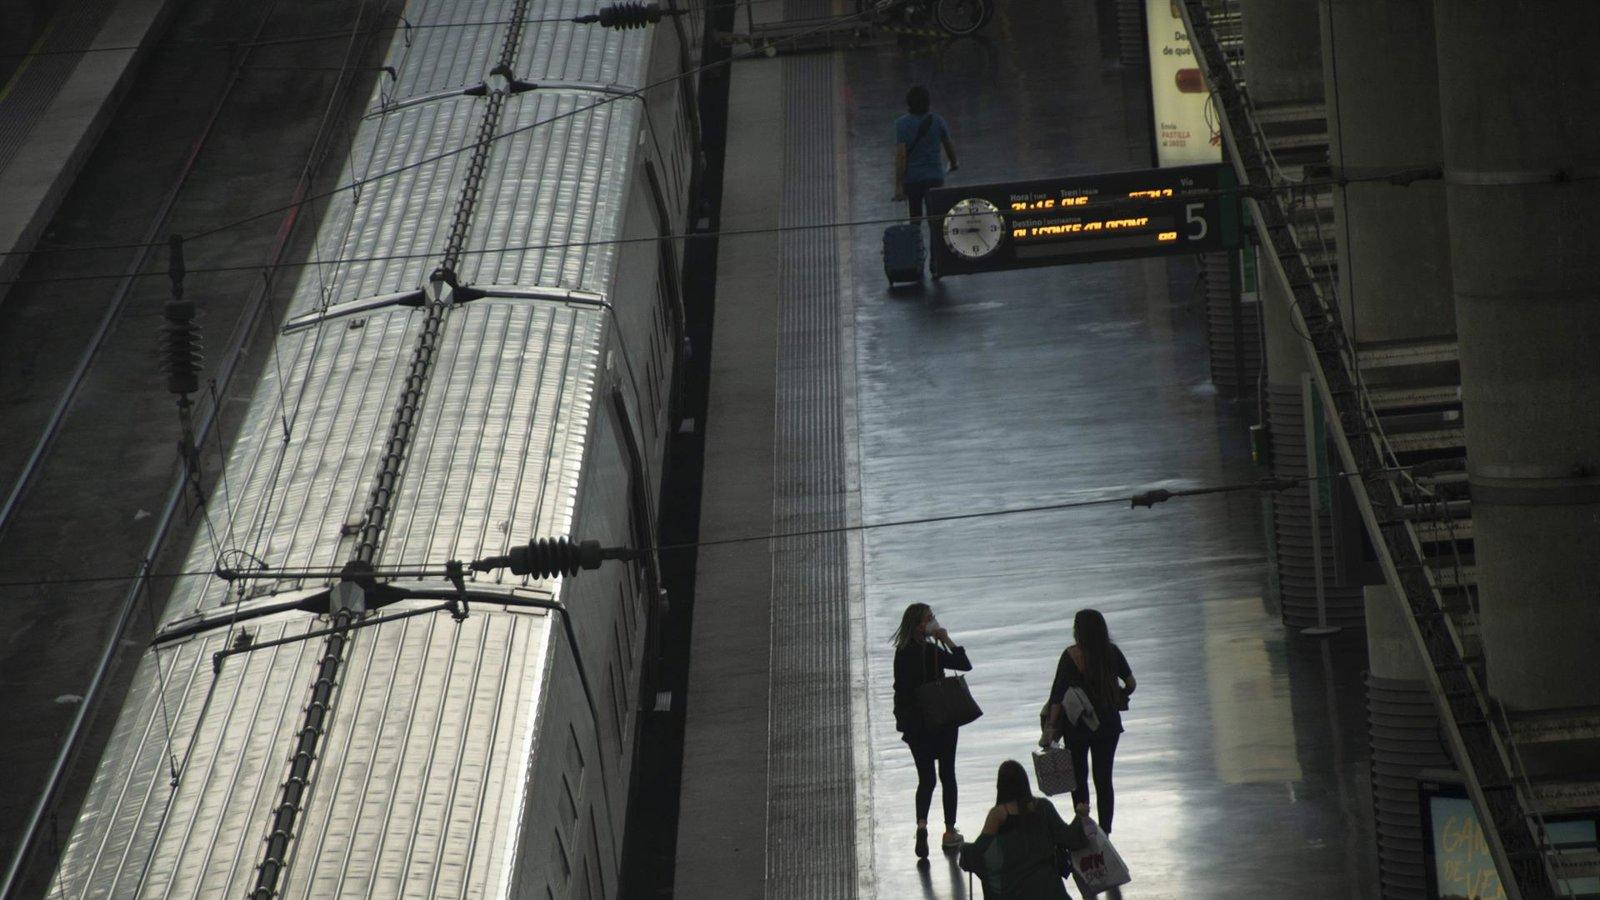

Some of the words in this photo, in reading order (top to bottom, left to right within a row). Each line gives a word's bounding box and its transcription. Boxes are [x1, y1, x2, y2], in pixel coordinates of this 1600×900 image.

[1163, 45, 1173, 55] de
[1010, 193, 1029, 202] Hora
[1060, 188, 1079, 197] Tren
[1012, 218, 1043, 229] Destino
[1185, 202, 1208, 241] 5
